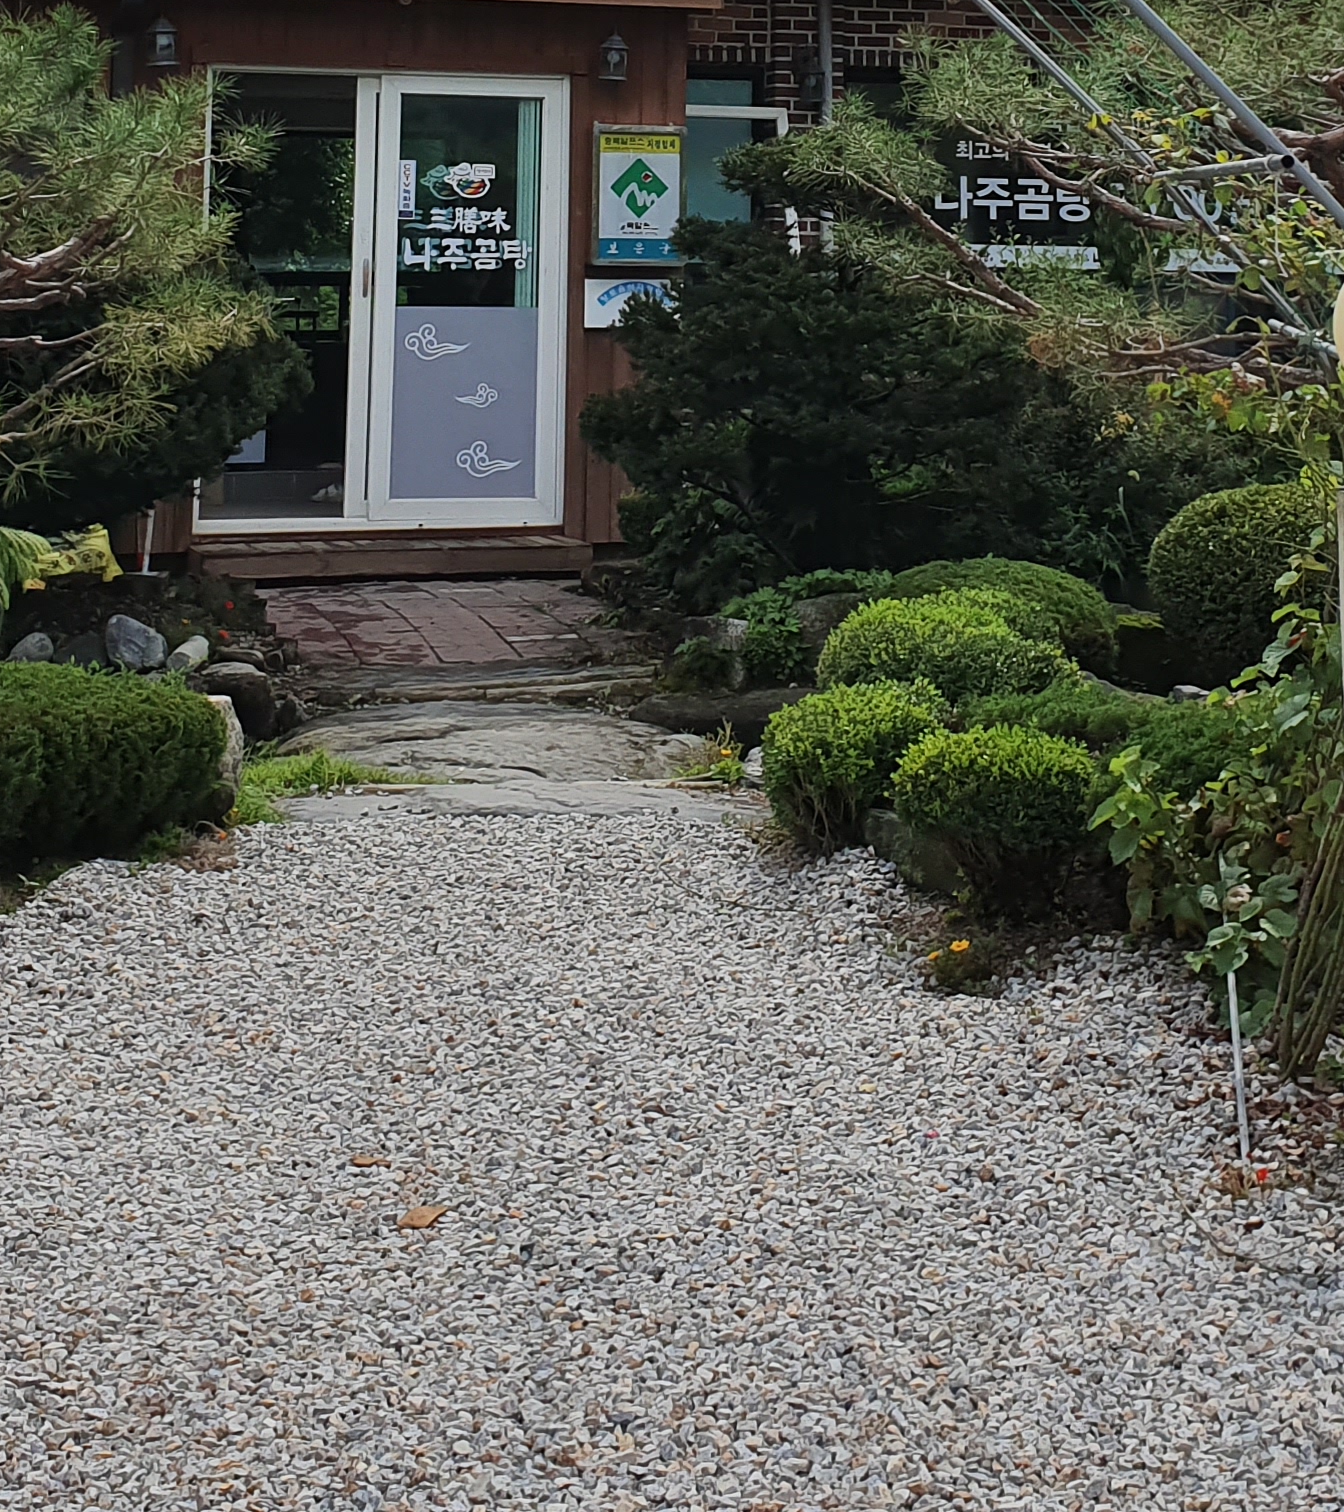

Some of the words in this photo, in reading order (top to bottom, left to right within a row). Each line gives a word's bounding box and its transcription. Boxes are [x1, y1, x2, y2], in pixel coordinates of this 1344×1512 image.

[935, 176, 1091, 222] 나주곰탕
[427, 207, 511, 234] 三膳味
[404, 237, 532, 271] 나주곰탕
